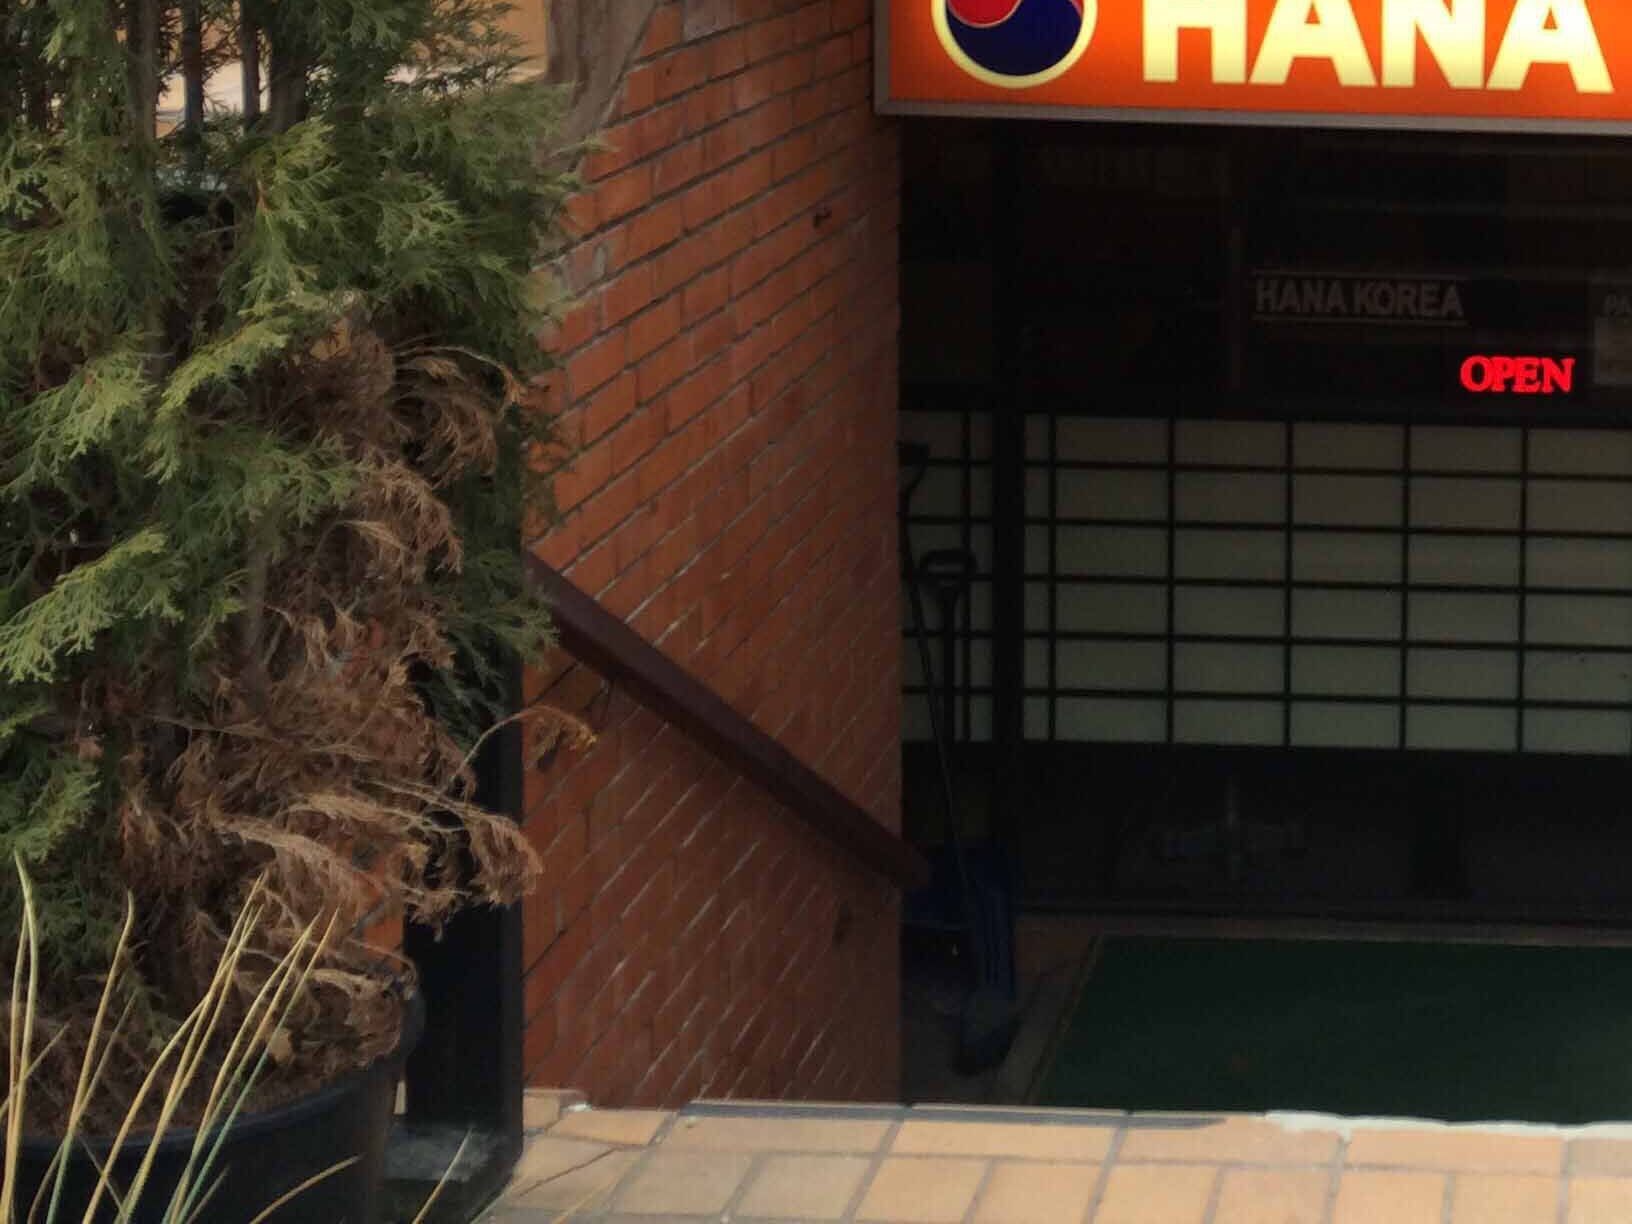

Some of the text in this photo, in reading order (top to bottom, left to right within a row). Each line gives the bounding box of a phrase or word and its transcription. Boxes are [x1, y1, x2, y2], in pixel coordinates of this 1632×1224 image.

[1256, 279, 1464, 317] HANA KOREA
[1459, 355, 1575, 393] OPEN
